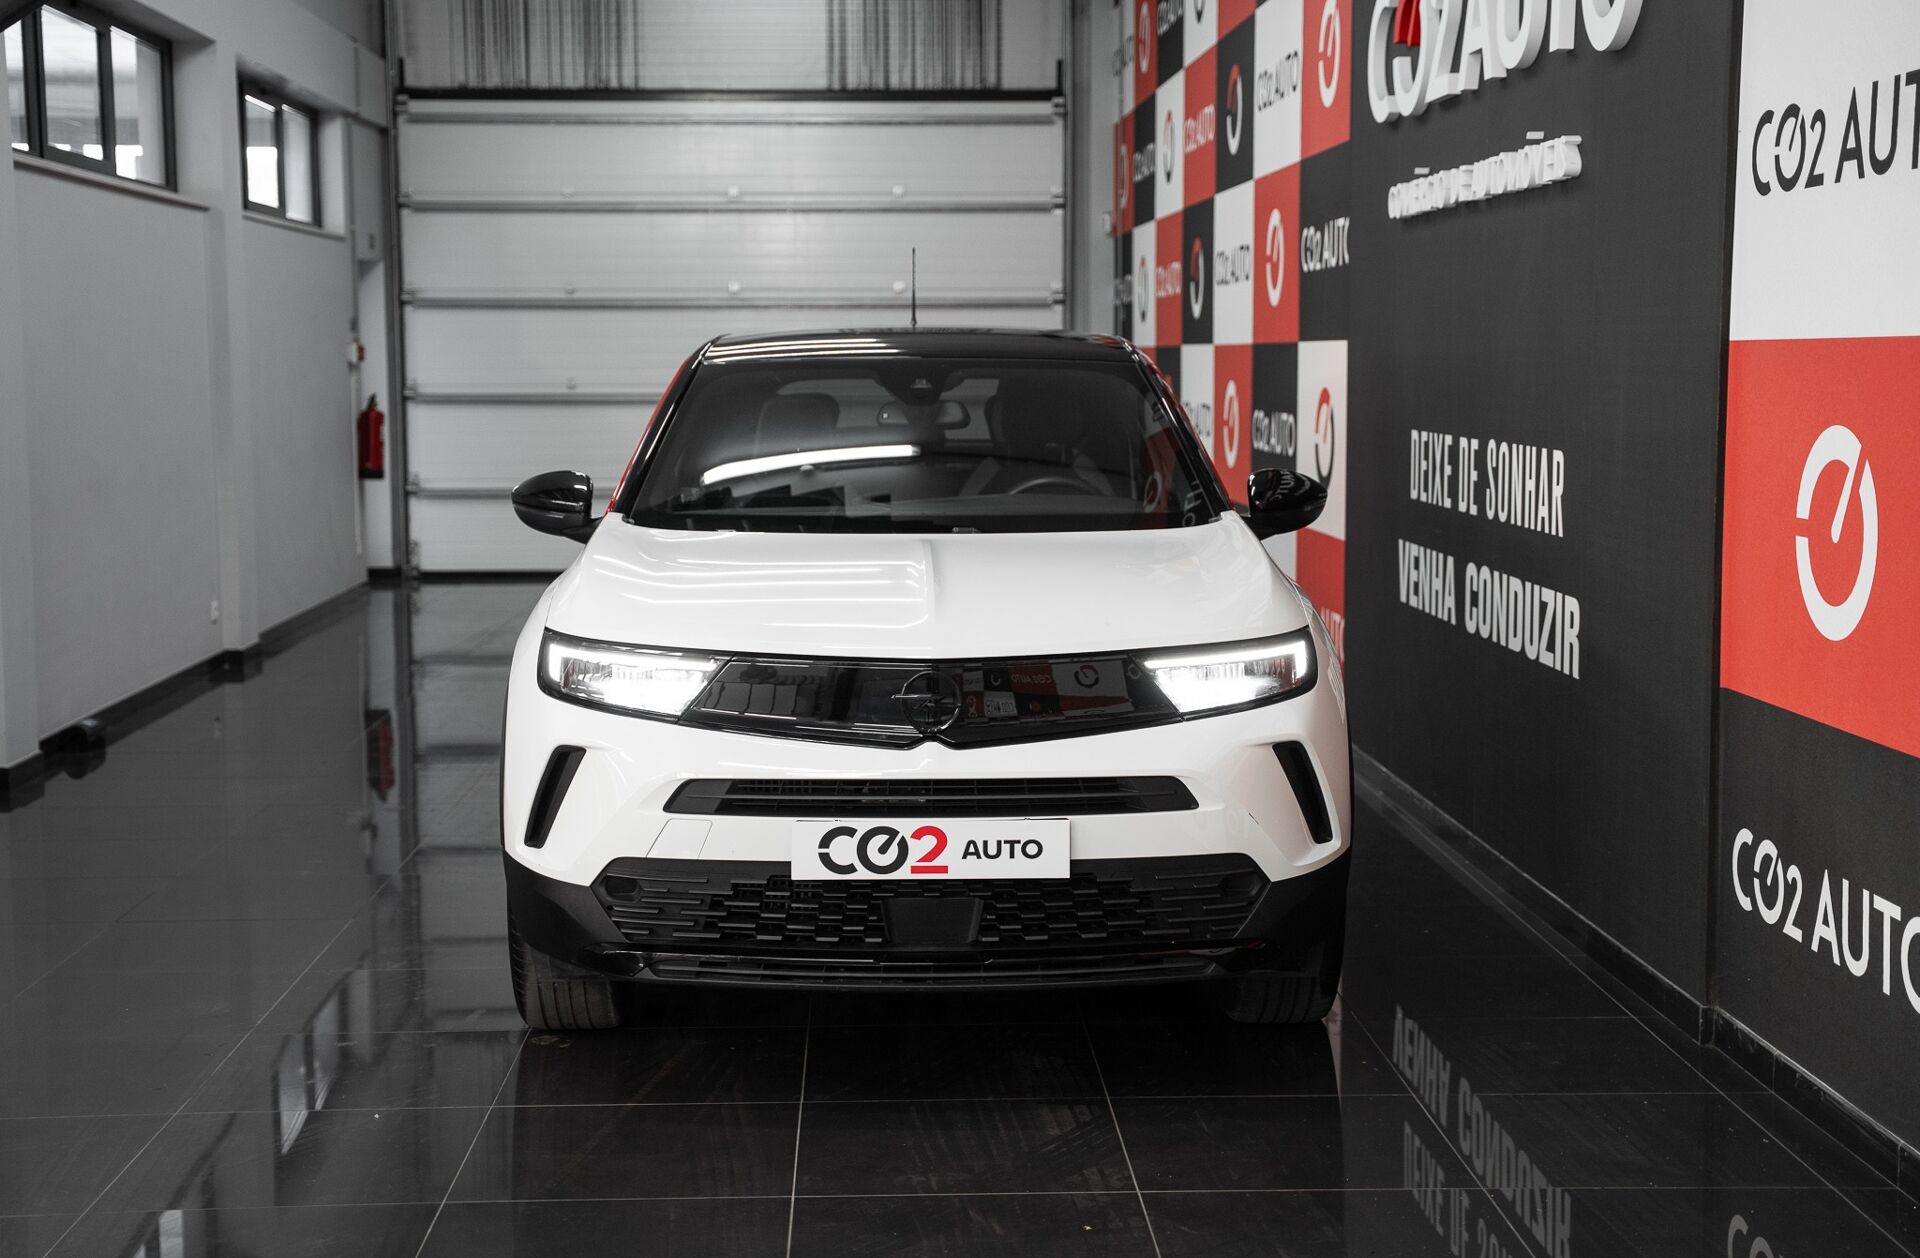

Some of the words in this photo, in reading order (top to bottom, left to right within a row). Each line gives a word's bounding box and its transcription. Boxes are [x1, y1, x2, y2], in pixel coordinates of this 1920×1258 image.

[1459, 0, 1646, 91] AU
[1752, 103, 1826, 196] CO2
[1411, 429, 1452, 509] DEIXE
[1458, 436, 1478, 516] DE
[1486, 438, 1564, 537] SONHAR
[1399, 538, 1456, 625] VENHA
[1465, 562, 1580, 680] CONDUZIR
[818, 825, 949, 875] CO2
[962, 839, 1043, 860] AUTO
[1732, 828, 1802, 943] CO2
